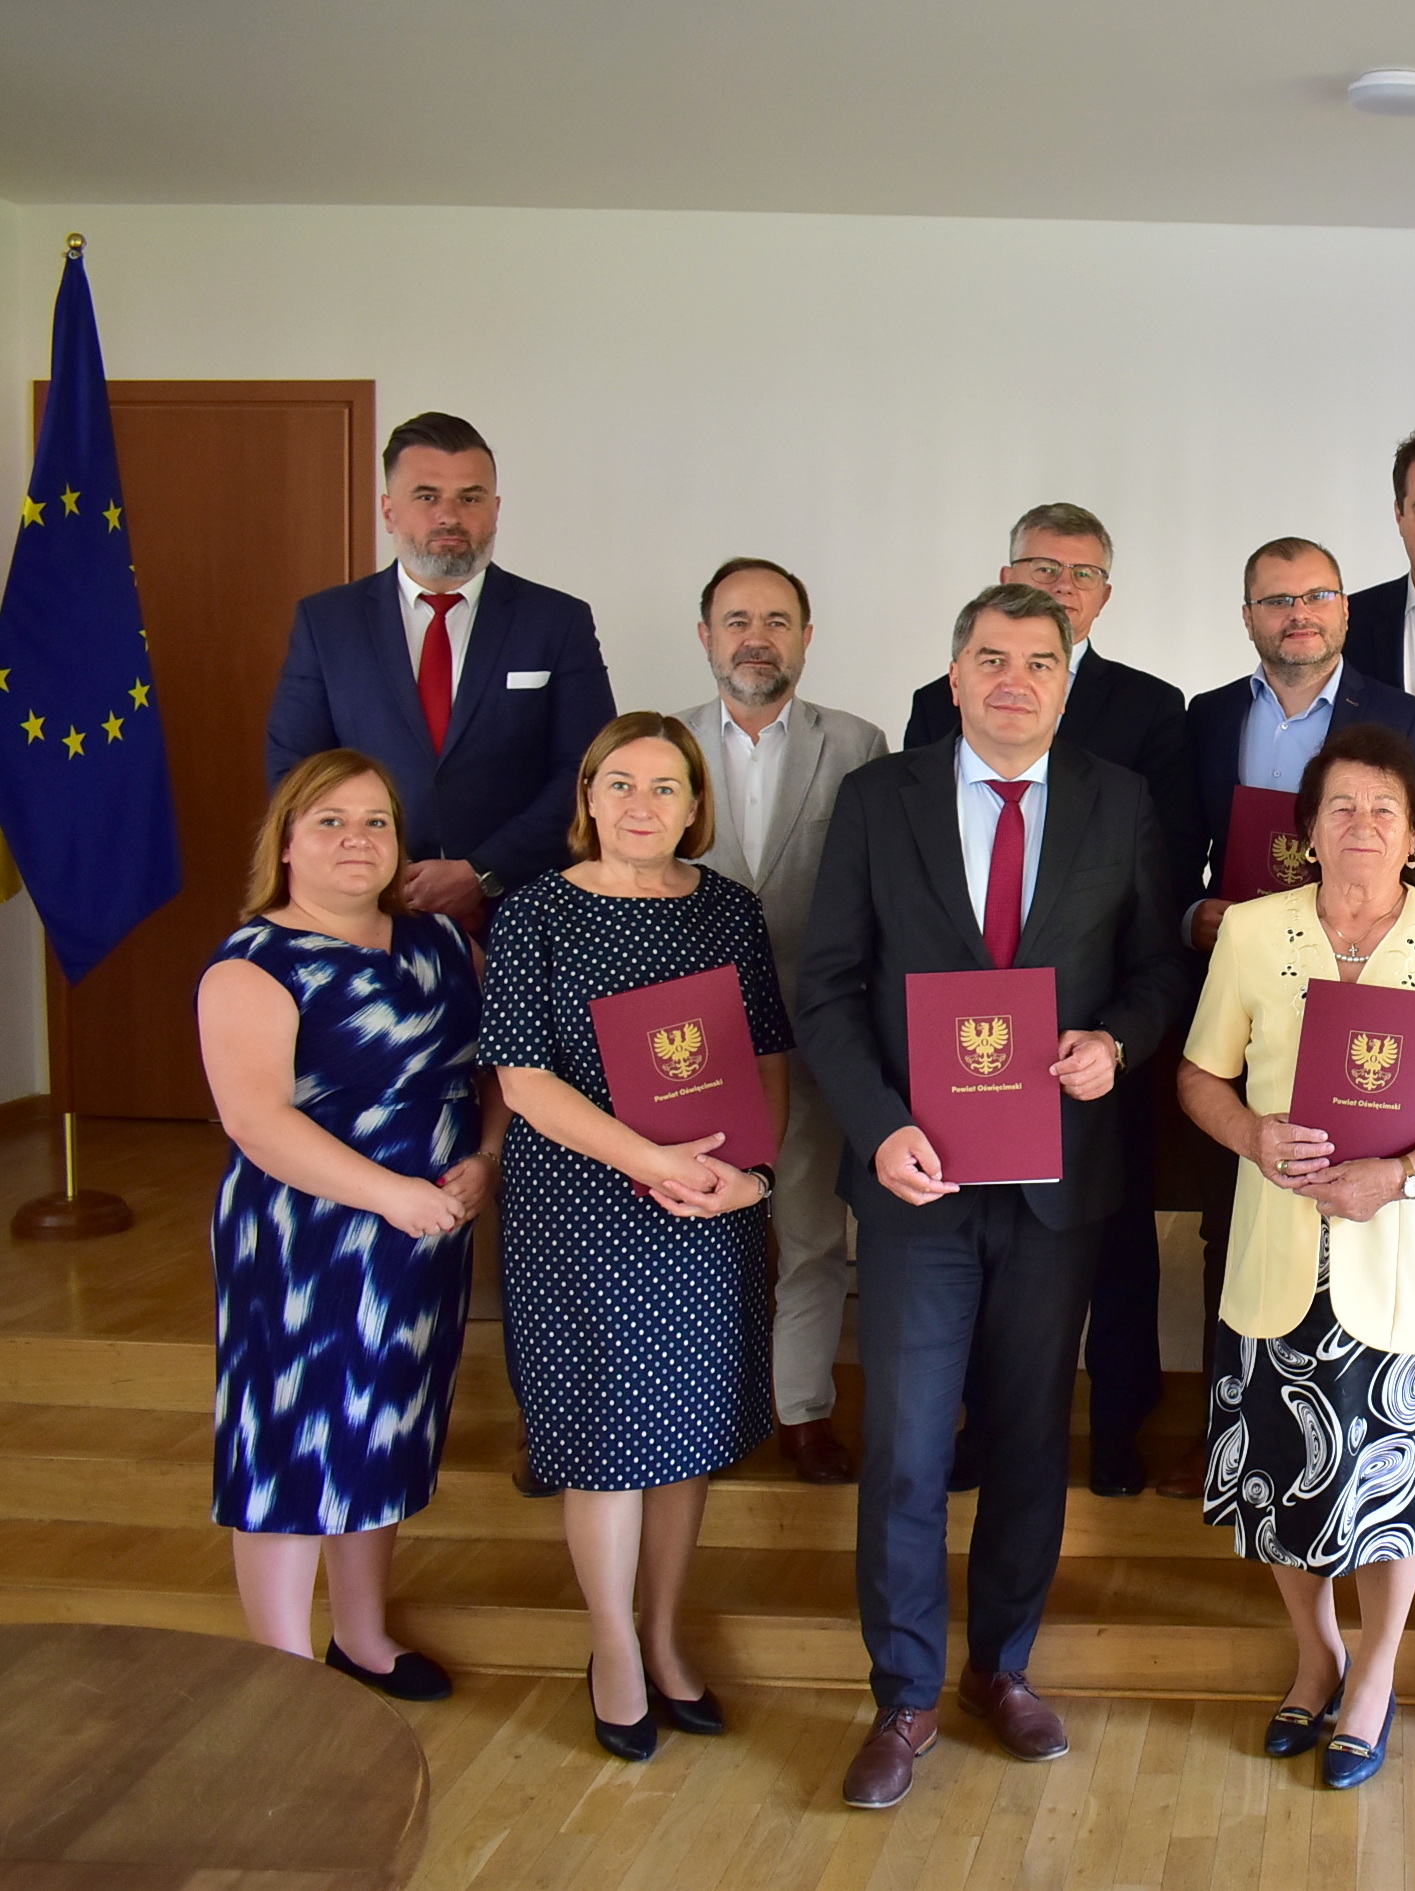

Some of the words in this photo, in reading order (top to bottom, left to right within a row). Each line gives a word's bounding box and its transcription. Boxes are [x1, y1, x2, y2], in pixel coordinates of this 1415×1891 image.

[654, 1091, 679, 1103] Powiat
[679, 1078, 724, 1096] Oświęcimski
[951, 1085, 977, 1093] Powiat
[977, 1082, 1023, 1093] Oświęcimski
[1332, 1096, 1358, 1107] Powiat
[1358, 1099, 1401, 1111] Oświęcimski
